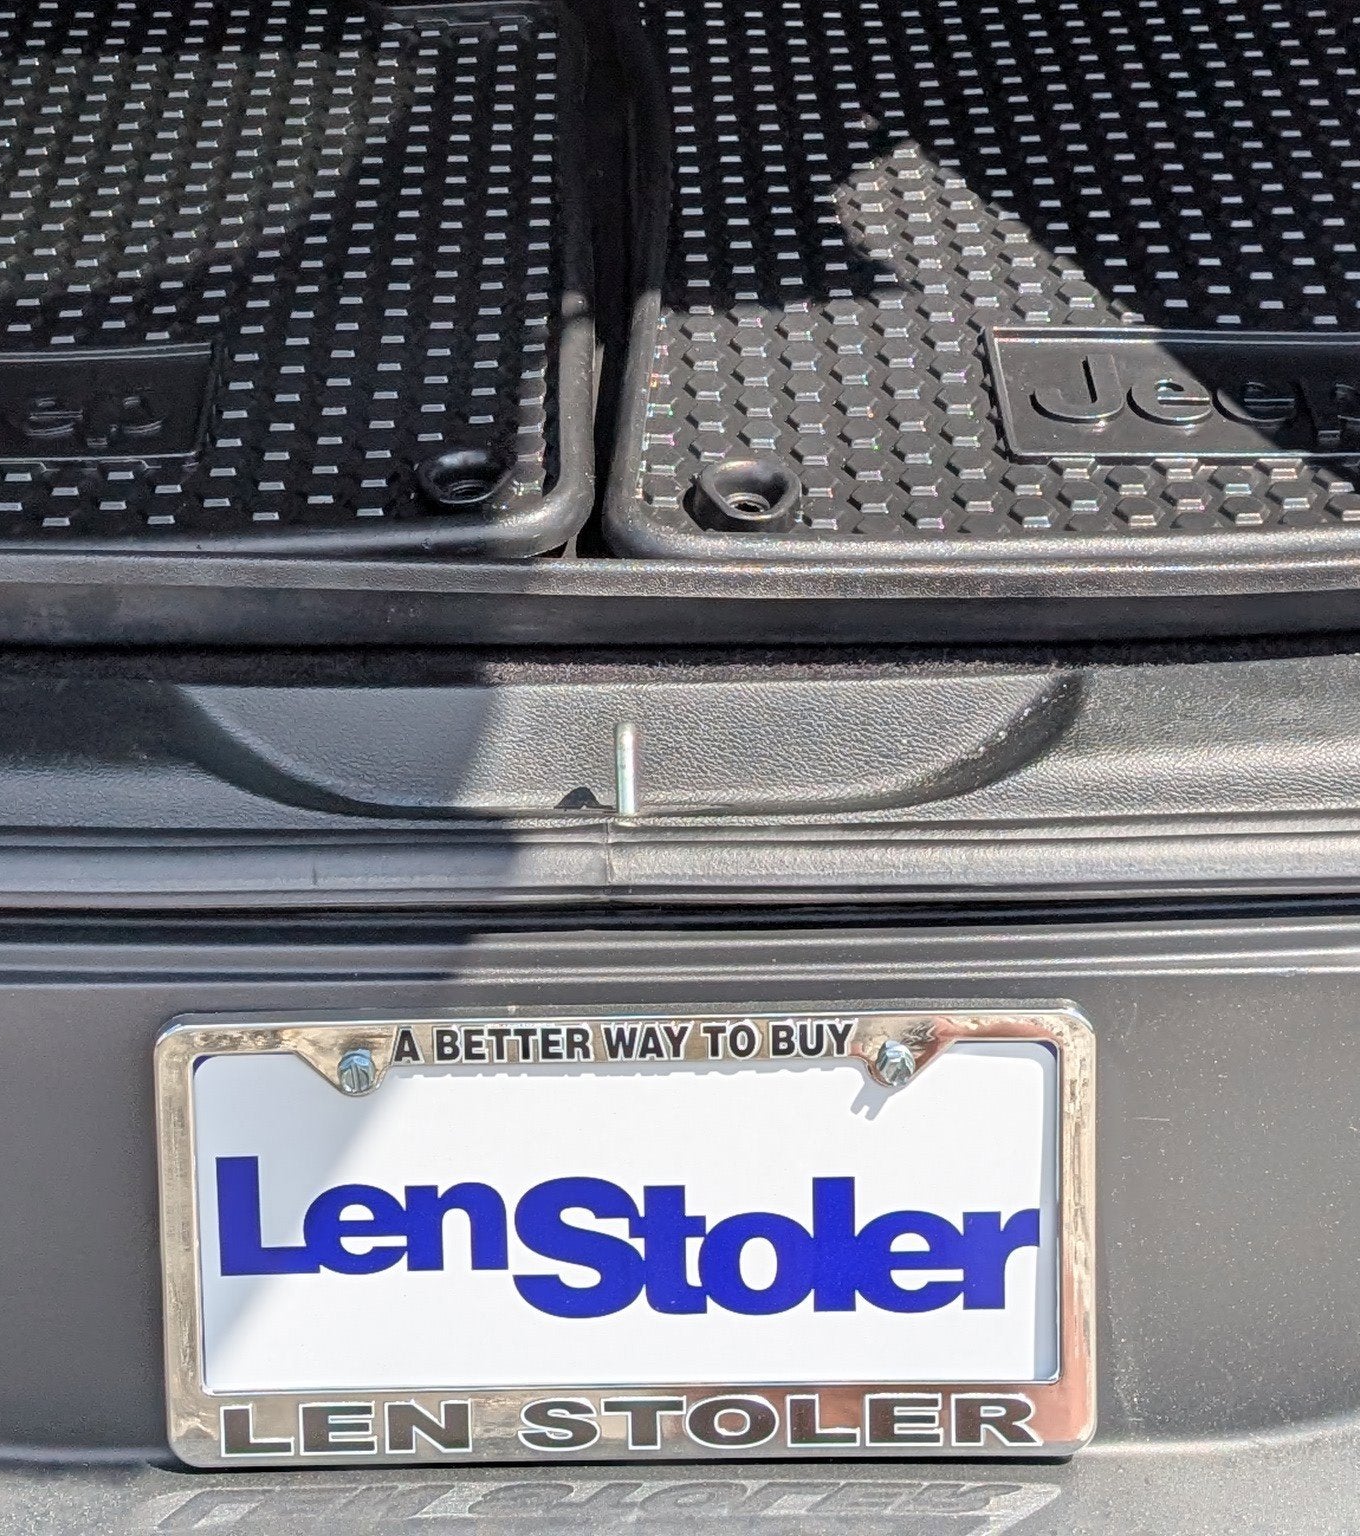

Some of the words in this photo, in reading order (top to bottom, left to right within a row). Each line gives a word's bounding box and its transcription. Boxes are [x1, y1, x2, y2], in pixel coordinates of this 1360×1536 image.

[392, 1024, 424, 1063] A
[433, 1023, 594, 1063] BETTER
[603, 1021, 691, 1061] WAY
[701, 1020, 759, 1059] TO
[769, 1018, 858, 1058] BUY
[219, 1397, 473, 1458] LEN
[519, 1392, 1043, 1453] STOLER
